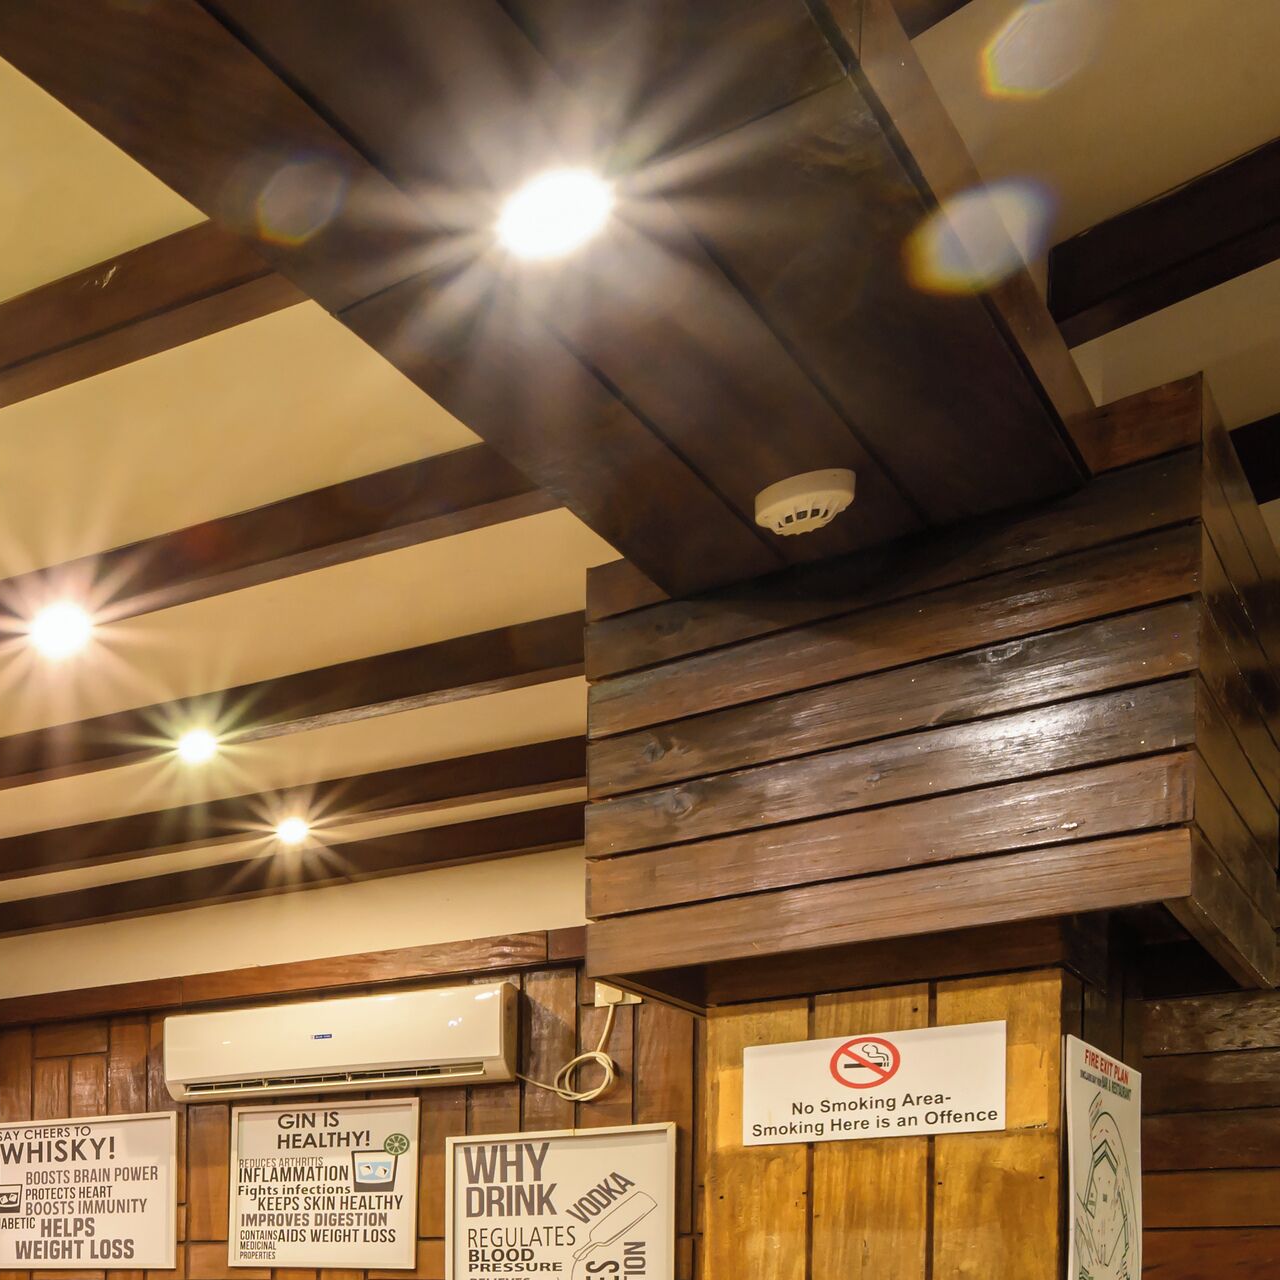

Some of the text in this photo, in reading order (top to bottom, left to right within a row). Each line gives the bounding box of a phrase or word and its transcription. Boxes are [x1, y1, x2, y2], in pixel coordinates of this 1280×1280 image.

[1085, 1049, 1099, 1069] FIRE
[1100, 1058, 1112, 1076] EXIT
[1114, 1065, 1129, 1085] PLAN
[792, 1093, 951, 1115] No Smoking Area-
[278, 1112, 339, 1129] GIN IS
[752, 1109, 998, 1137] Smoking Here is an Offence
[24, 1128, 70, 1140] CHEERS
[76, 1126, 91, 1136] TO
[277, 1131, 370, 1149] HEALTHY!
[0, 1137, 115, 1164] WHISKY!
[239, 1157, 323, 1168] REDUCES ARTHRITIS
[464, 1142, 550, 1184] WHY
[26, 1166, 158, 1185] BOOSTS BRAIN POWER
[239, 1166, 348, 1183] INFLAMMATION
[26, 1185, 112, 1200] PROTECTS HEART
[238, 1184, 351, 1201] Fights infections
[466, 1171, 635, 1224] DRINK VODKA
[26, 1199, 147, 1215] BOOSTS IMMUNITY
[258, 1195, 403, 1210] KEEPS SKIN HEALTHY
[41, 1218, 95, 1238] HELPS
[241, 1213, 387, 1227] IMPROVES DIGESTION
[240, 1230, 277, 1240] CONTAINS
[278, 1229, 396, 1242] AIDS WEIGHT LOSS
[468, 1226, 575, 1248] REGULATES
[16, 1239, 134, 1259] WEIGHT LOSS
[240, 1241, 276, 1250] MEDICINAL
[240, 1251, 275, 1259] PROPERTIES
[469, 1248, 535, 1262] BLOOD
[469, 1262, 563, 1272] PRESSURE
